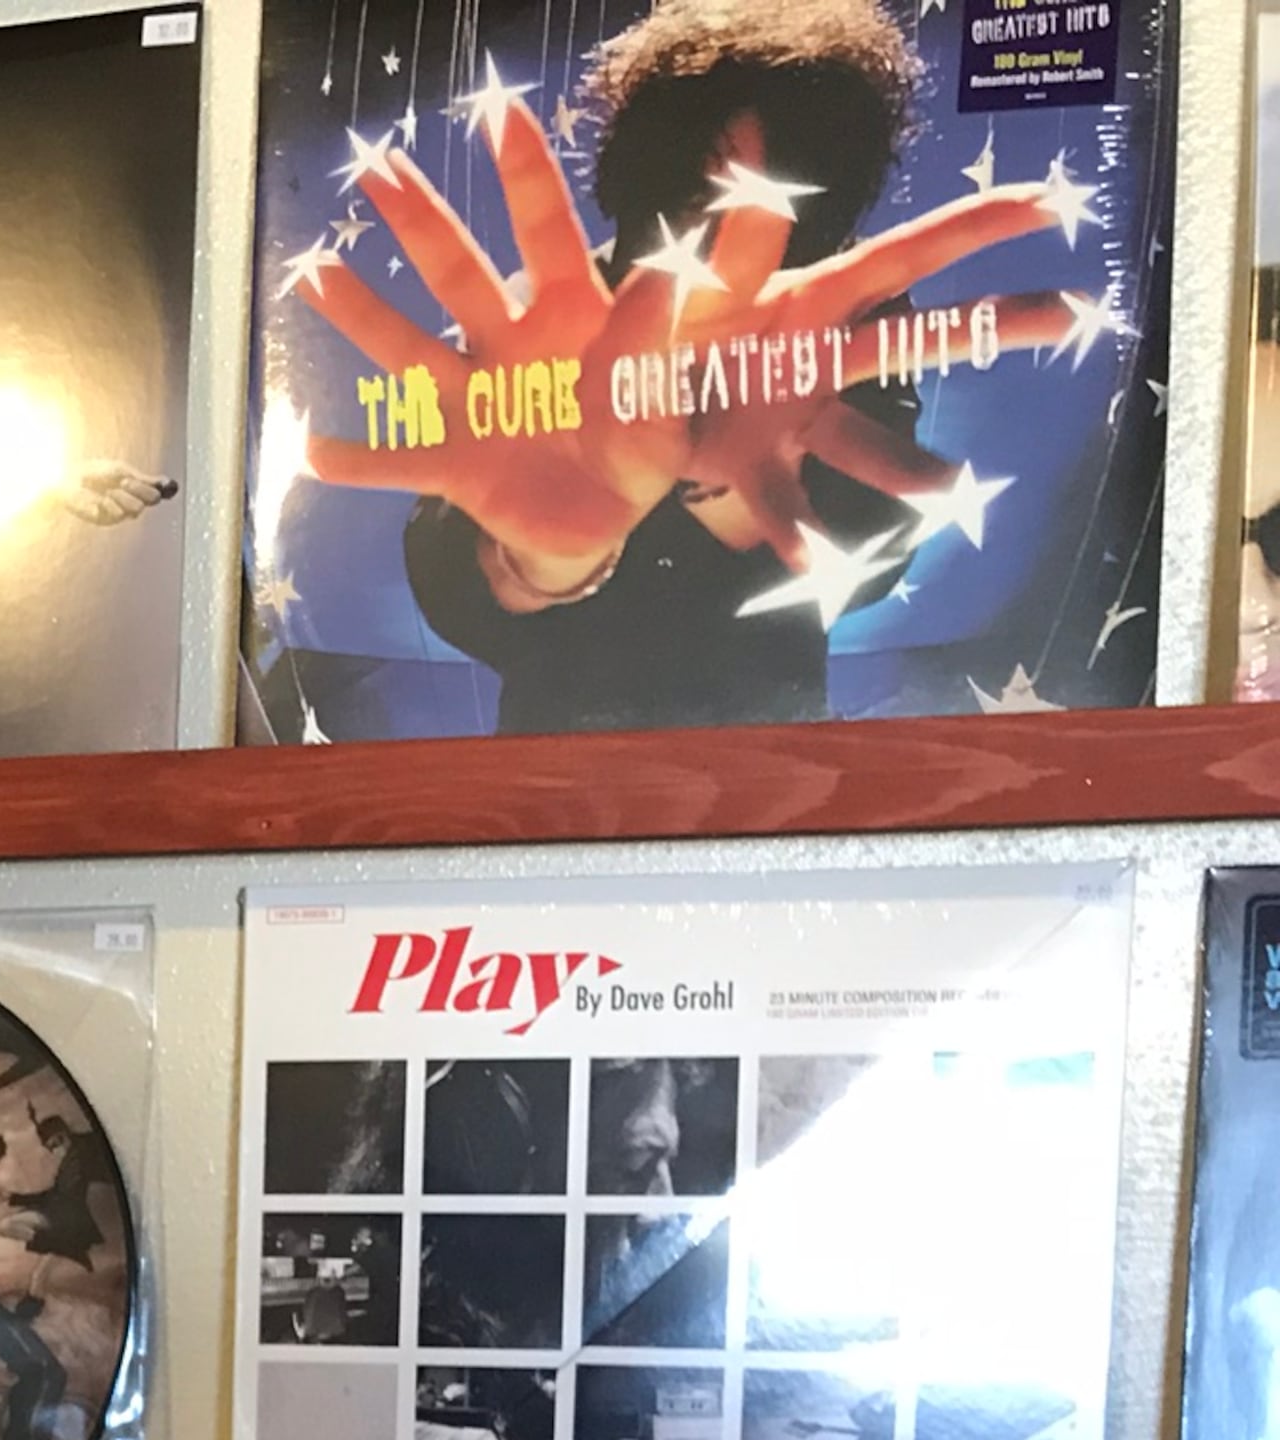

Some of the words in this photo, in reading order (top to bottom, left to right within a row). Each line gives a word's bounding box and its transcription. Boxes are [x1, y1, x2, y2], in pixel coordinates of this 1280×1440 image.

[971, 11, 1059, 44] GREATEST
[1066, 4, 1110, 33] HITS
[1018, 52, 1050, 69] Gram
[1053, 49, 1083, 67] Vinyl
[970, 72, 1027, 88] Remastered
[1029, 72, 1040, 86] by
[1042, 70, 1073, 83] Robert
[1075, 67, 1104, 81] Smith
[358, 364, 446, 450] THE
[467, 357, 583, 439] CURE
[610, 326, 851, 424] GREATEST
[876, 301, 998, 388] HITS
[346, 926, 587, 1036] Play
[575, 986, 603, 1015] By
[610, 986, 664, 1012] Dave
[671, 982, 735, 1011] Grohl
[789, 991, 838, 1005] MINUTE
[843, 990, 937, 1004] COMPOSITION
